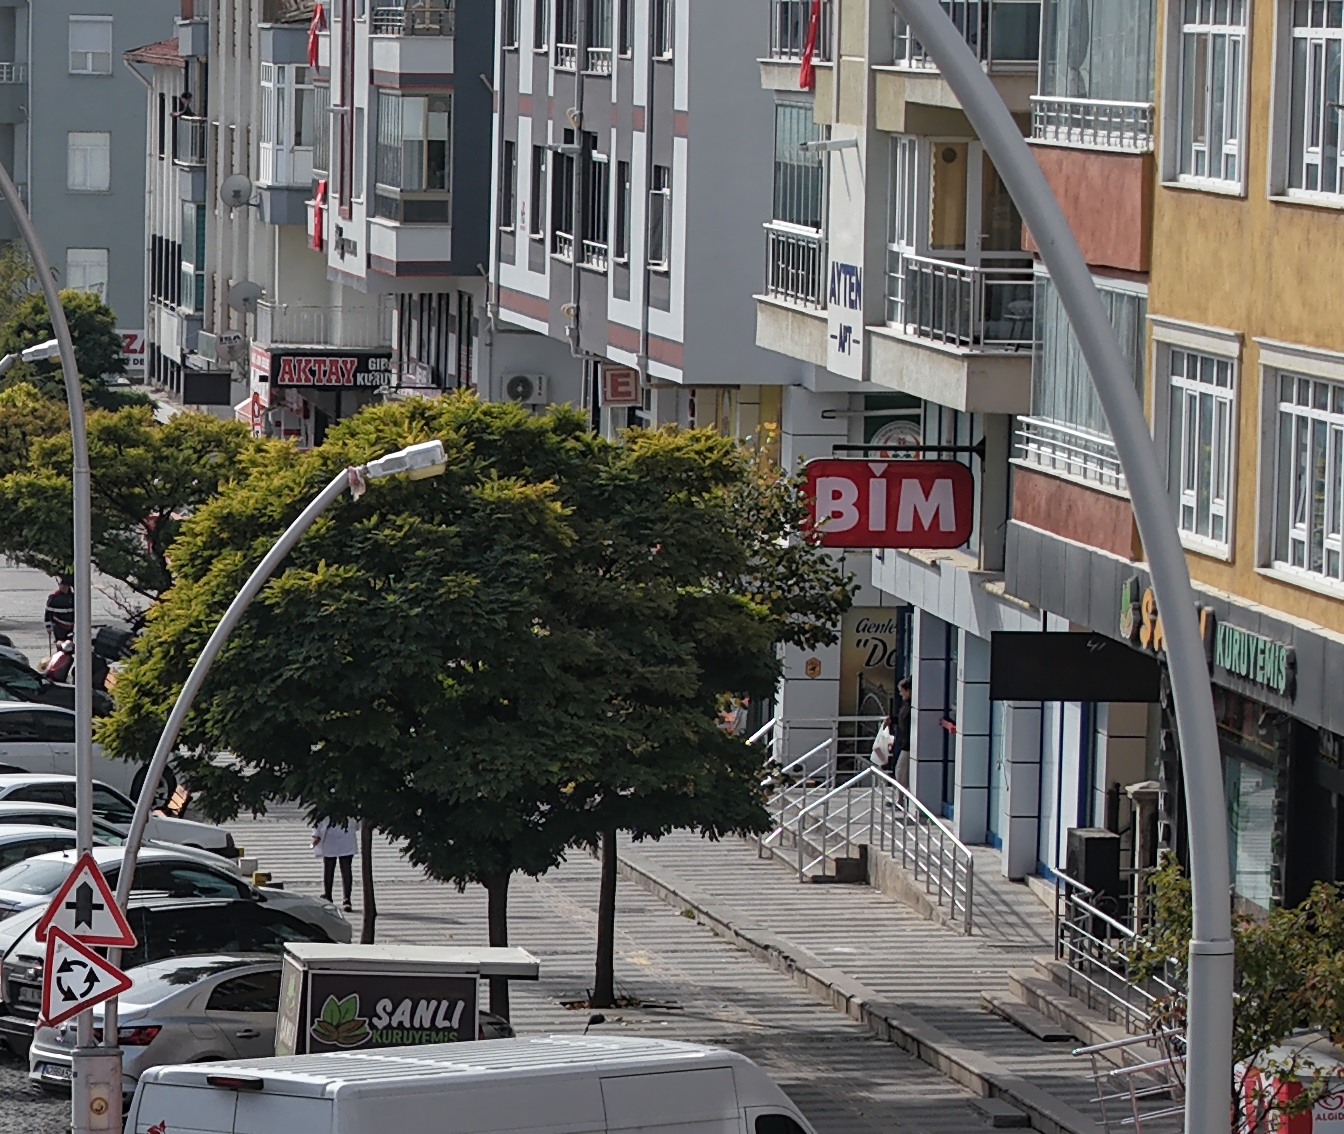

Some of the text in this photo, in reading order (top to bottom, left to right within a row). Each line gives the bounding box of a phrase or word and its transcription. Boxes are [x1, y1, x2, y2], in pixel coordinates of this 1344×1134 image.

[829, 261, 862, 311] AYTEN
[278, 356, 358, 386] AKTAY
[611, 373, 632, 398] E
[815, 462, 957, 533] BİM
[1215, 620, 1287, 696] KURUYEMİŞ
